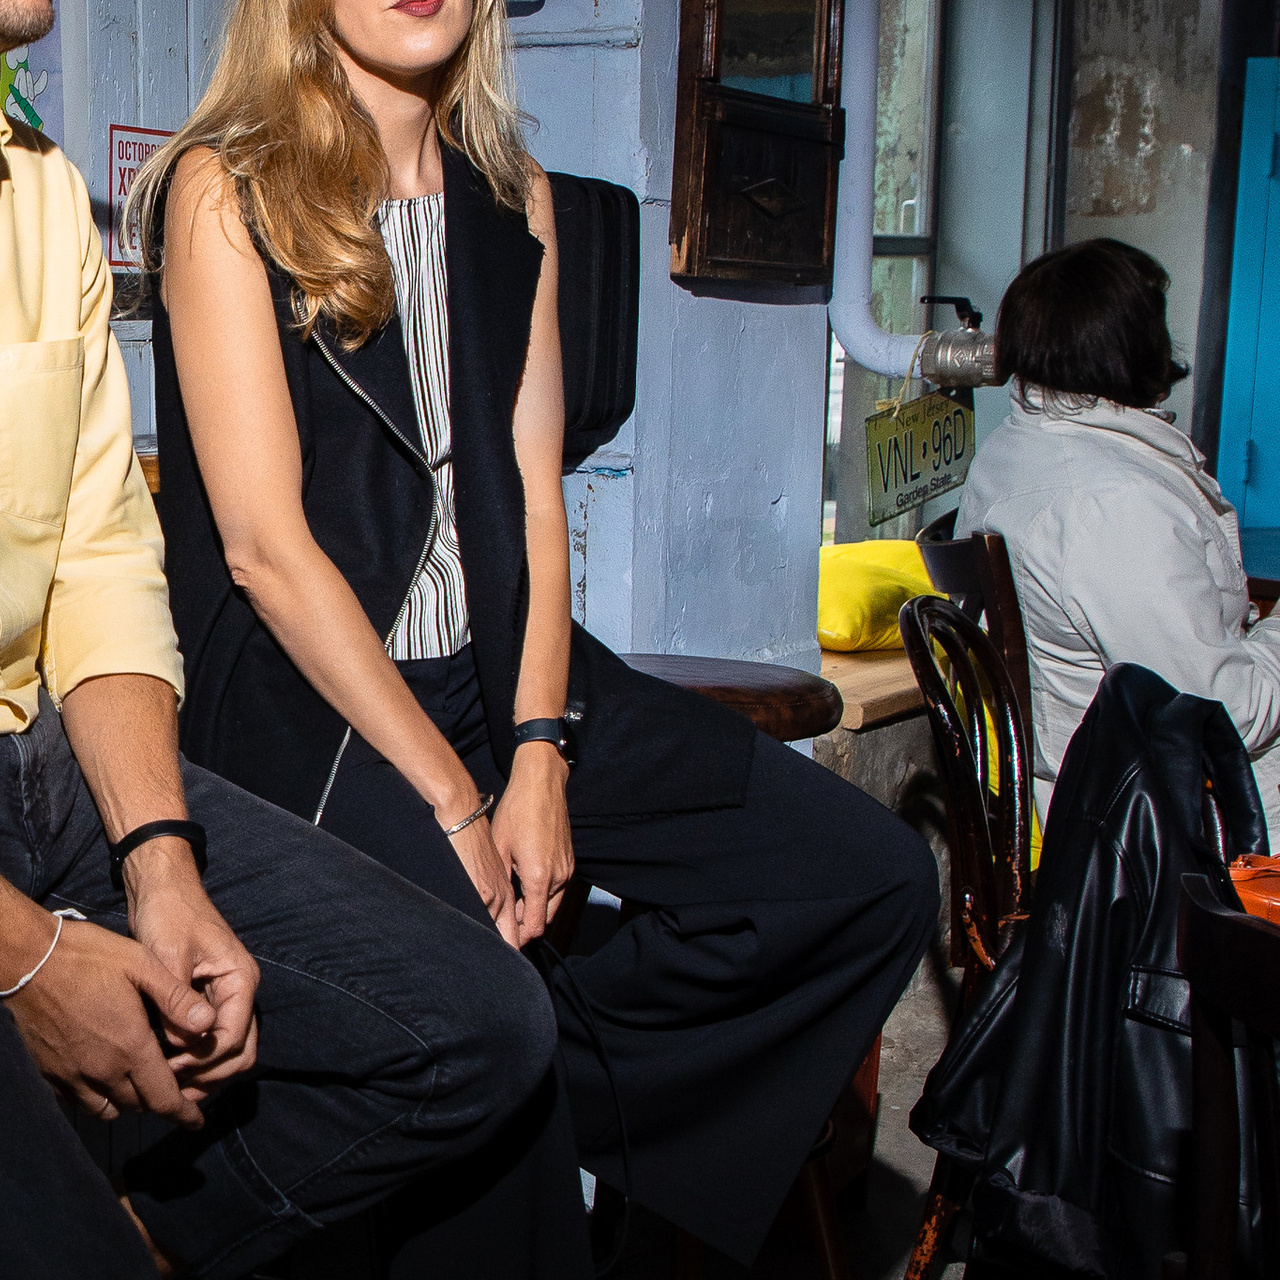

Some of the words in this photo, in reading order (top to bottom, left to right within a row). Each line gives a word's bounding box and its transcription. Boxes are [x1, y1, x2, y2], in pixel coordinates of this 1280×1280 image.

[118, 139, 160, 163] ОСТОР
[895, 411, 920, 431] New
[922, 399, 950, 425] Jersey
[931, 408, 967, 472] 96D
[895, 482, 928, 508] Garden
[929, 473, 952, 492] State
